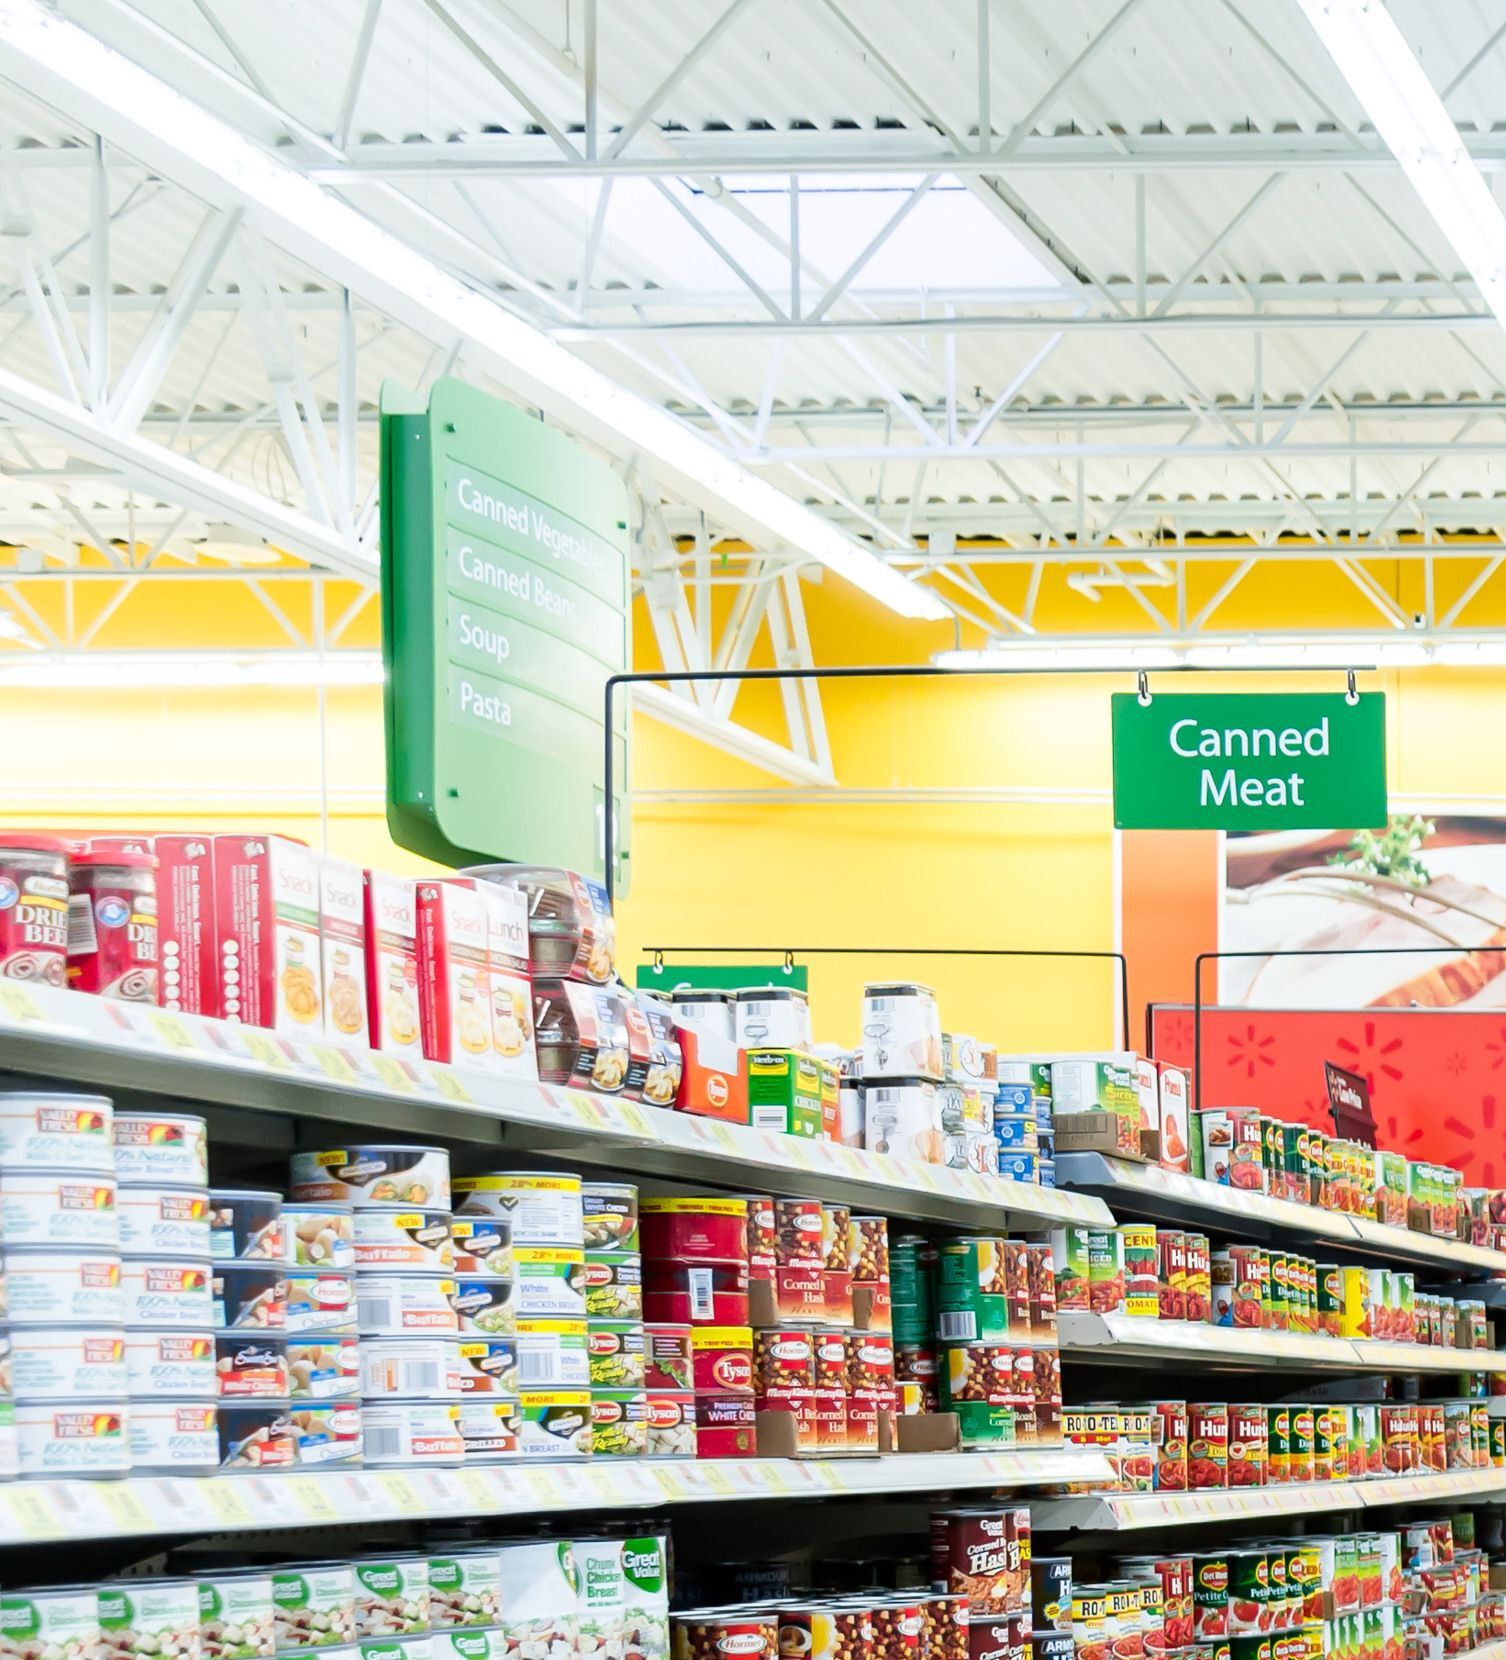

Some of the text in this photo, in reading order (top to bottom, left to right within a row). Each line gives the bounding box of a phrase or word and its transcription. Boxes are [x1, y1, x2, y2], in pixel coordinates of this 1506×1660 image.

[458, 480, 529, 536] Canned
[458, 546, 530, 599] Canned
[460, 614, 510, 662] Soup
[461, 682, 511, 726] Pasta
[1169, 717, 1329, 757] Canned
[1201, 769, 1304, 806] Meat
[326, 880, 358, 910] Snack
[624, 1550, 660, 1568] Great
[633, 1567, 660, 1578] Value
